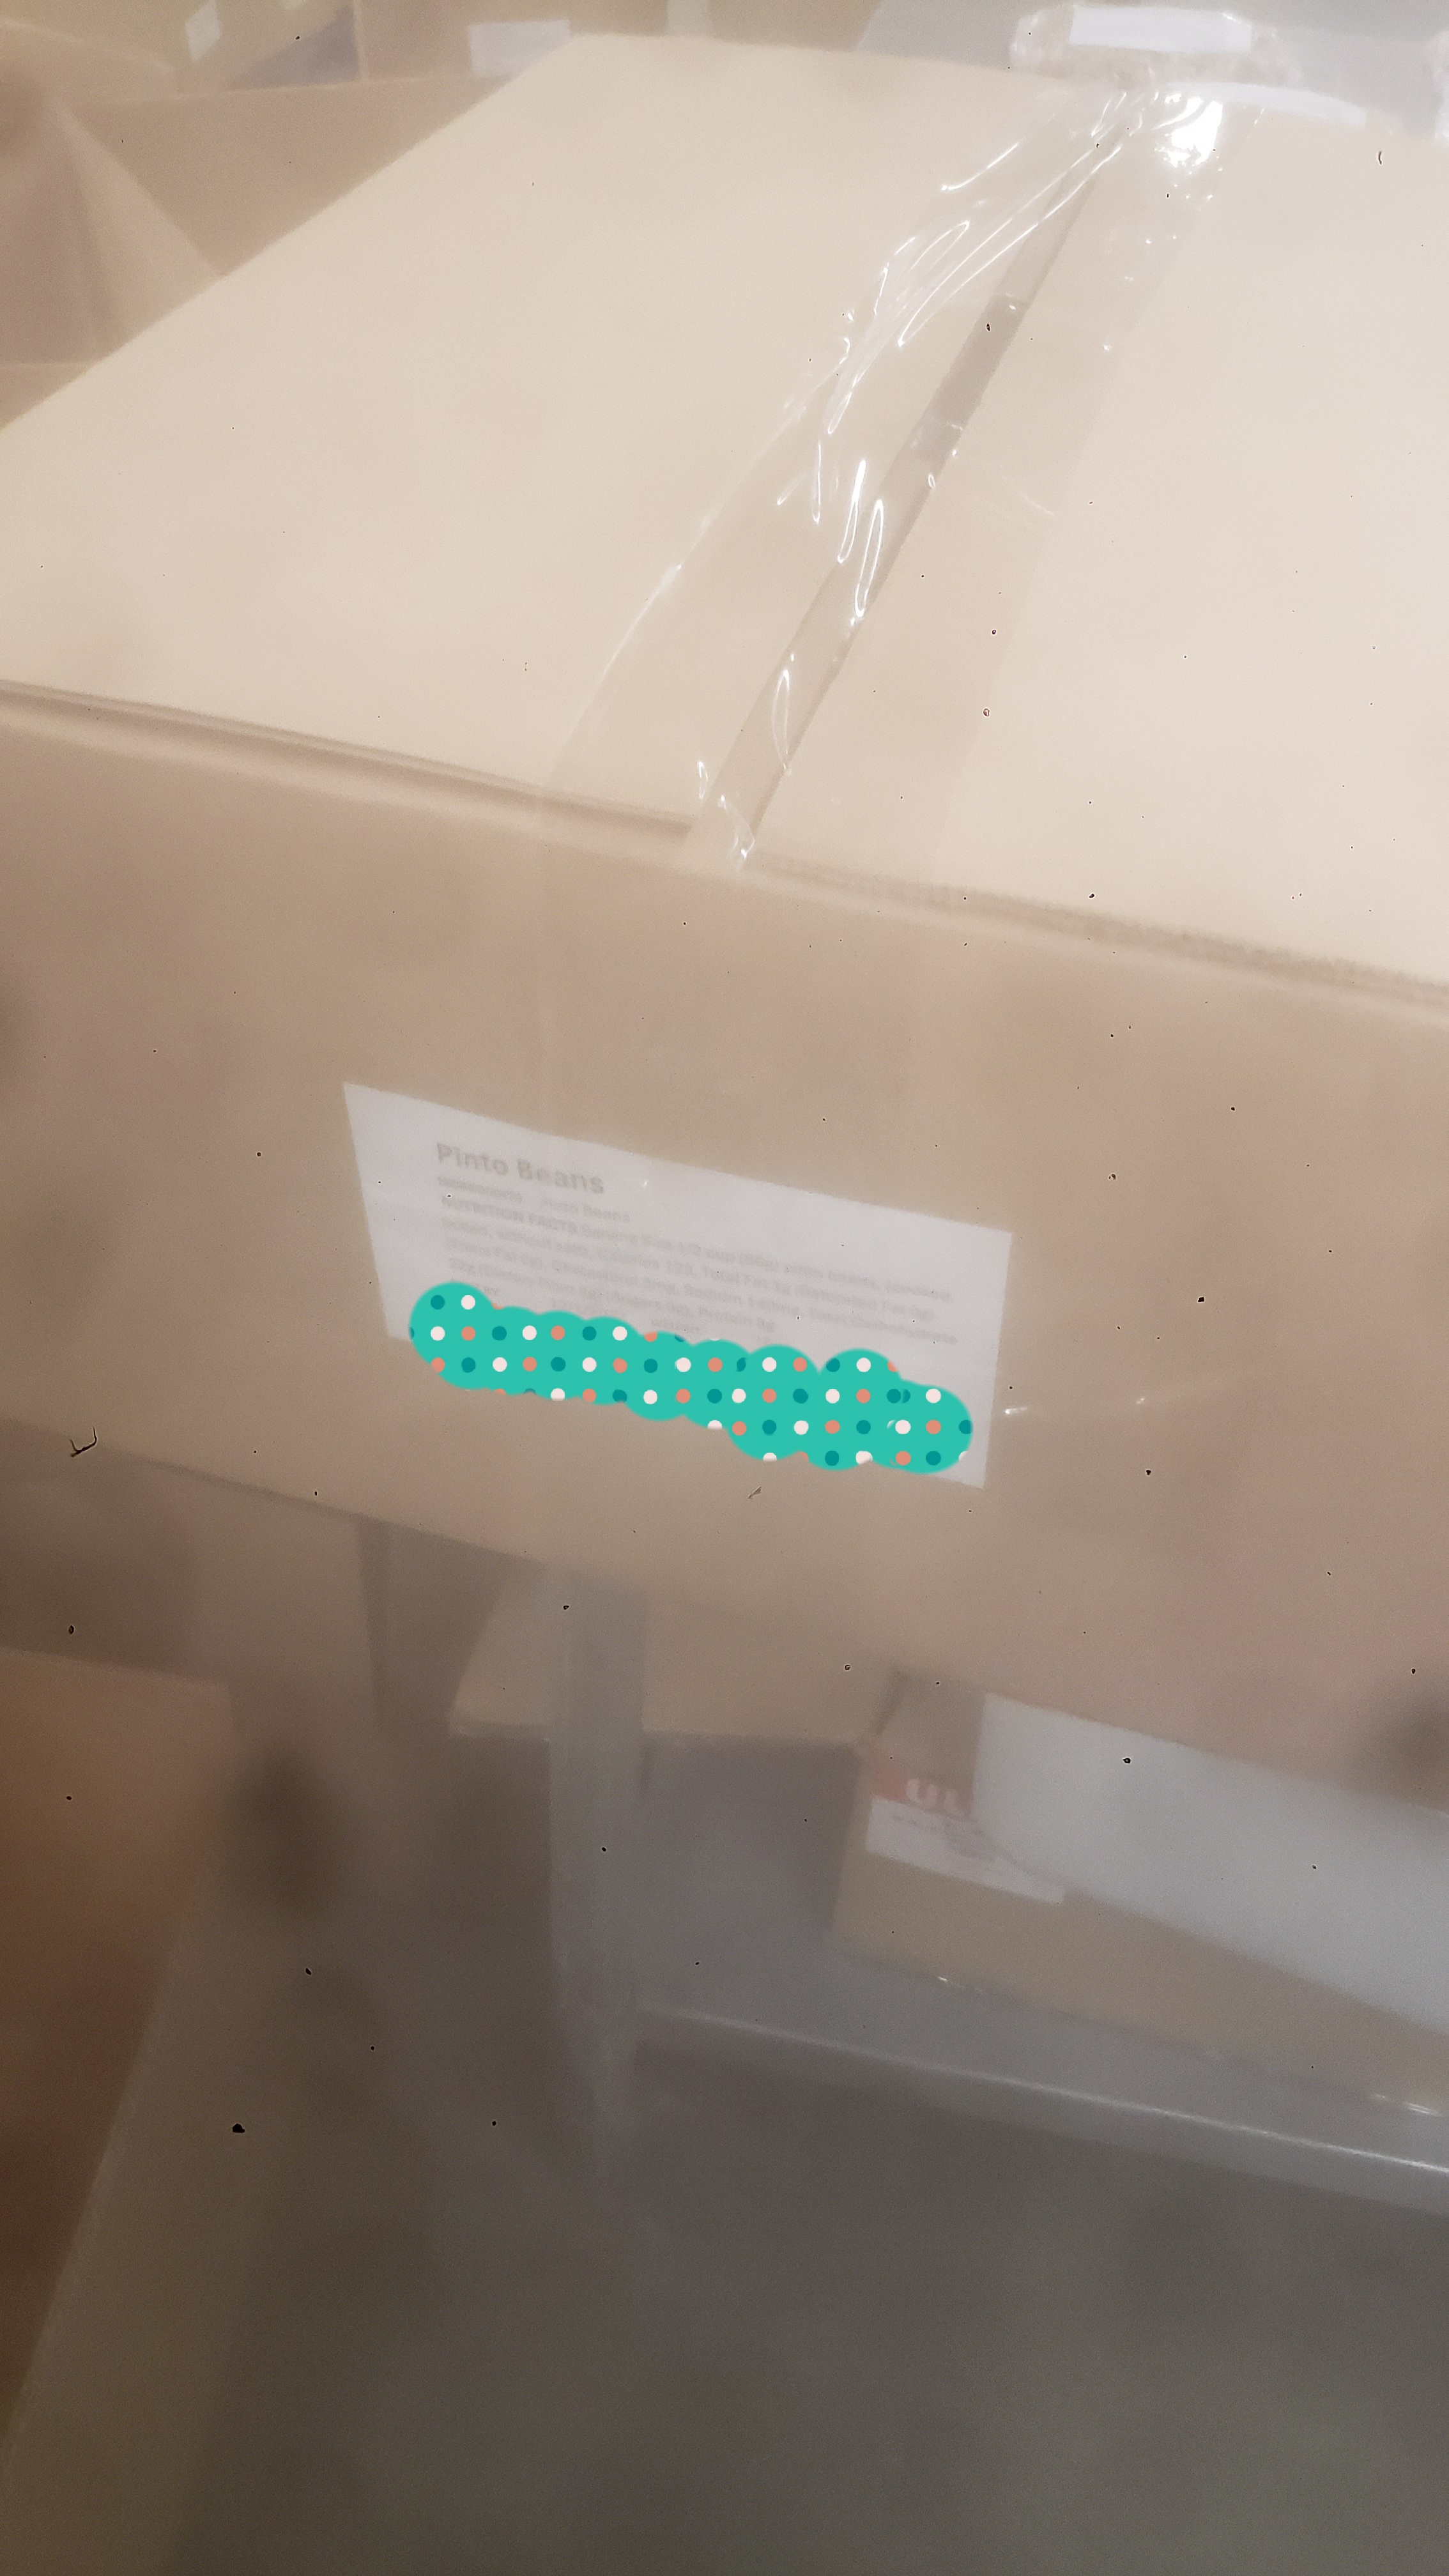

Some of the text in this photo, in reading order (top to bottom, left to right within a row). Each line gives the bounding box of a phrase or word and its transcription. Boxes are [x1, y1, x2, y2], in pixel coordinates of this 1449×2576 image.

[437, 1141, 604, 1195] Pinto Beans
[441, 1195, 524, 1223] NUTRITION
[528, 1213, 576, 1233] FACTS
[582, 1204, 631, 1224] Beans
